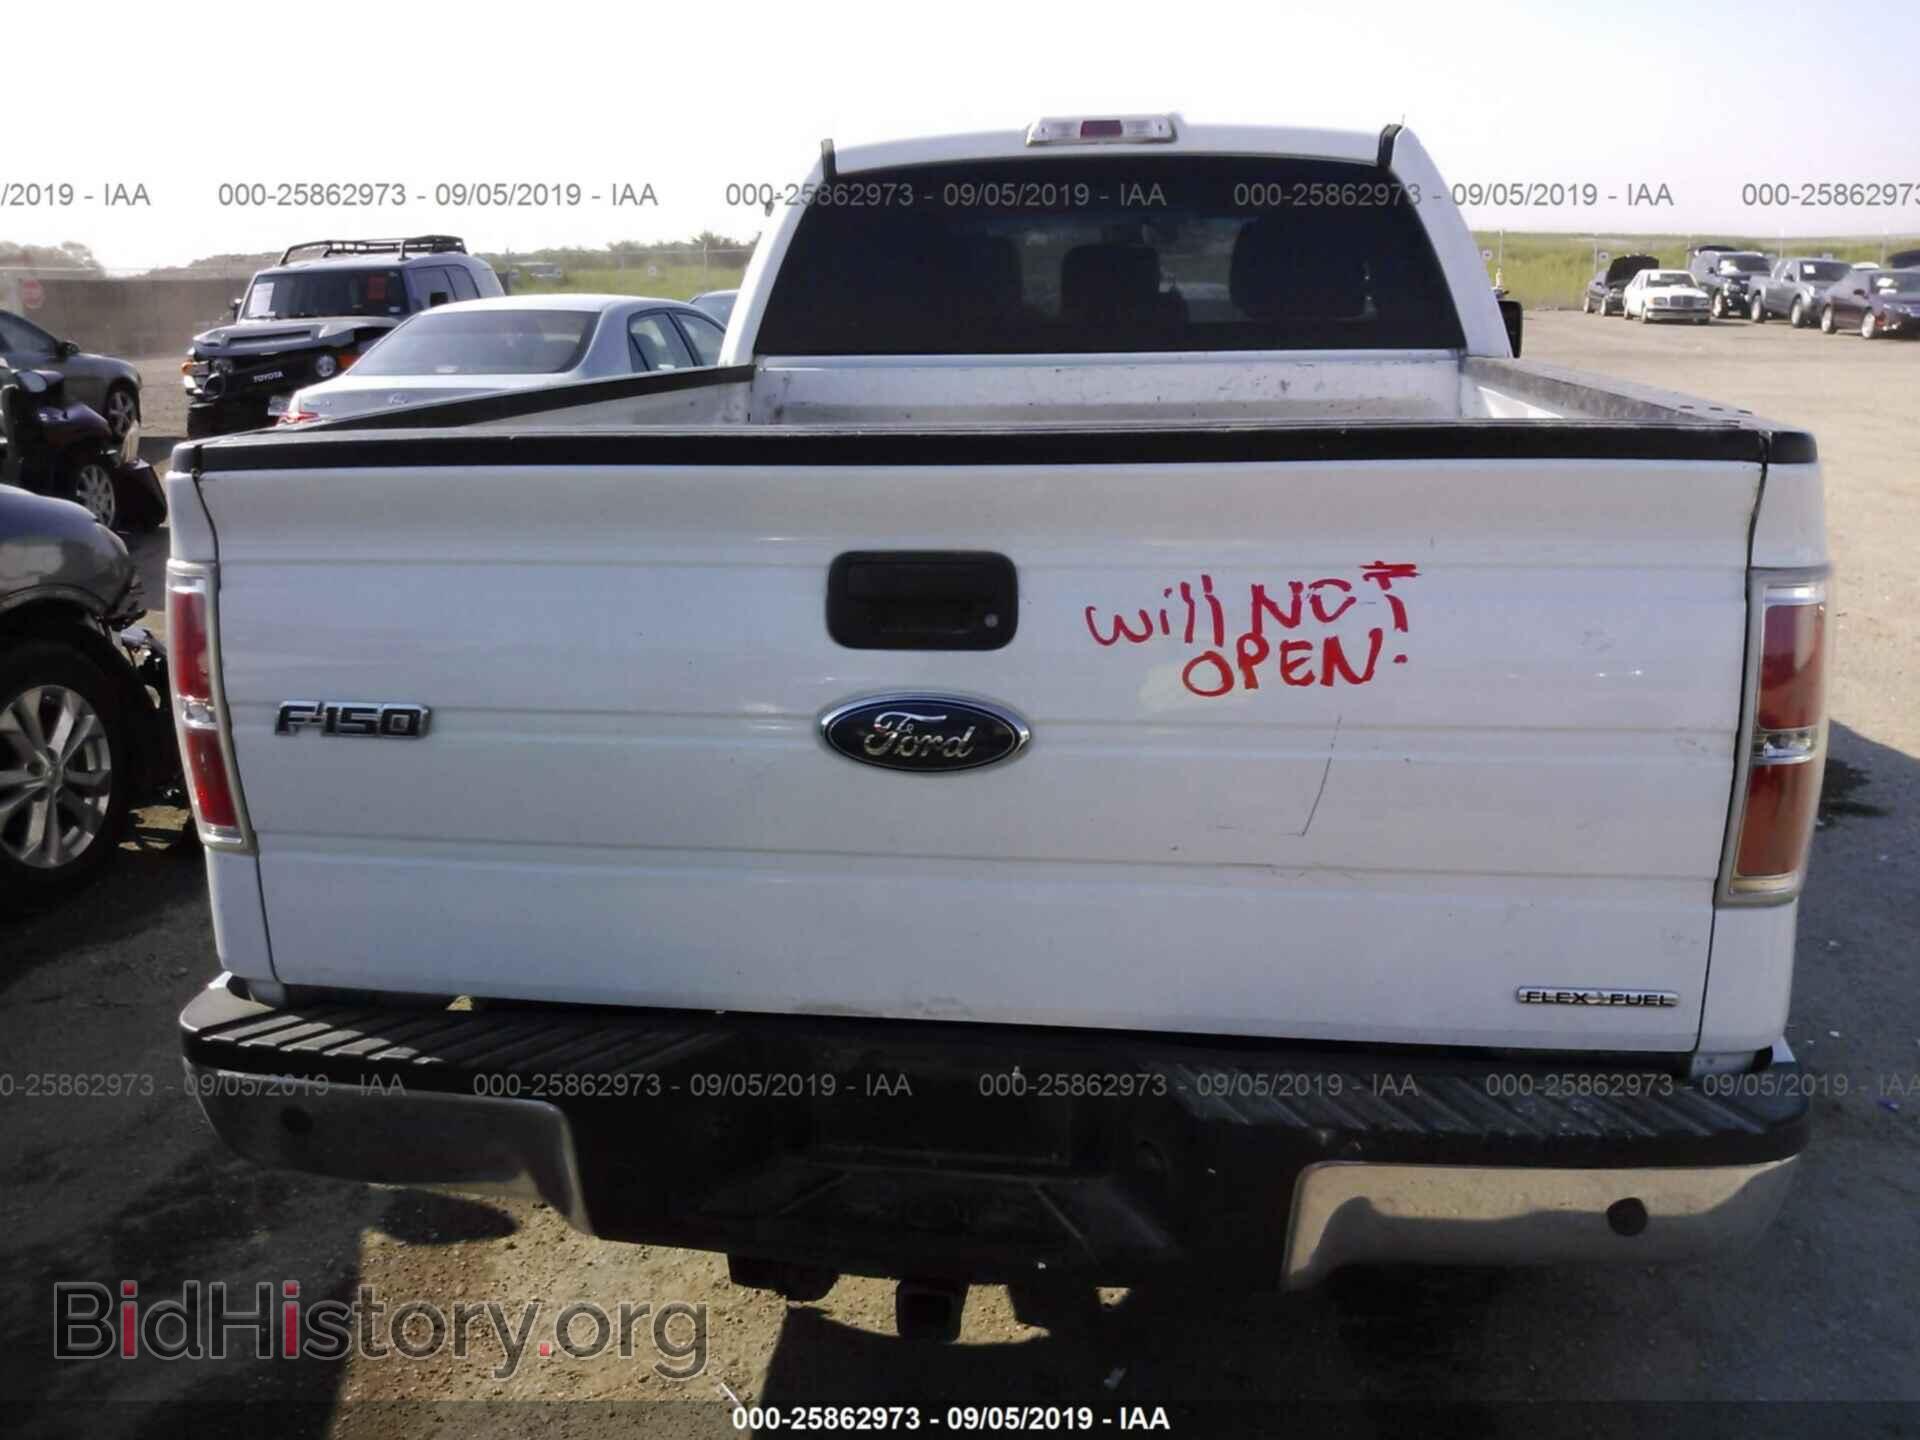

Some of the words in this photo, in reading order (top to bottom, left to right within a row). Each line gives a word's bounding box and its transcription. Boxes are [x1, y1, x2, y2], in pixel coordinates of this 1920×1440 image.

[253, 371, 284, 382] TOYOTA
[1250, 561, 1422, 637] NOT
[275, 700, 432, 740] F-150
[863, 711, 976, 758] Ford
[1526, 991, 1590, 1005] FLEX
[1609, 992, 1668, 1007] FUEL
